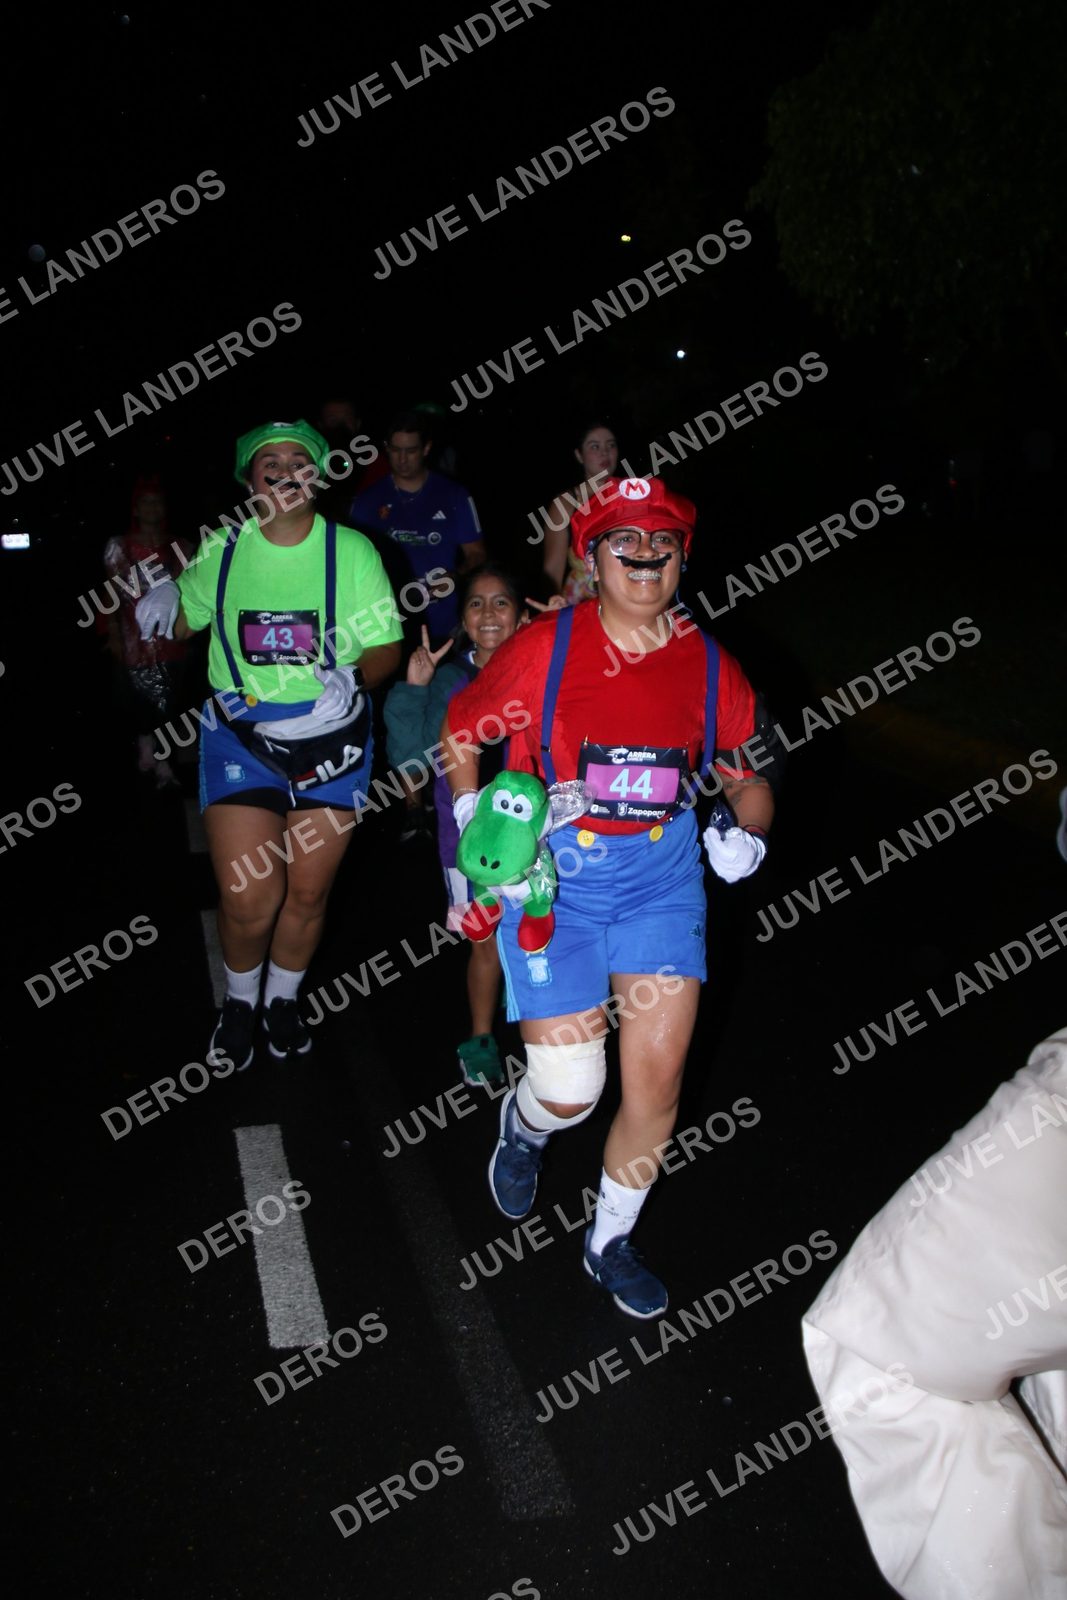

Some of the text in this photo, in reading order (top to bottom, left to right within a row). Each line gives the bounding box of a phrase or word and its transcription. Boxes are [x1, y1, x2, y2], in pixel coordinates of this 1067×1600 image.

[262, 627, 294, 649] 43
[294, 744, 363, 791] FILA
[609, 768, 653, 799] 44
